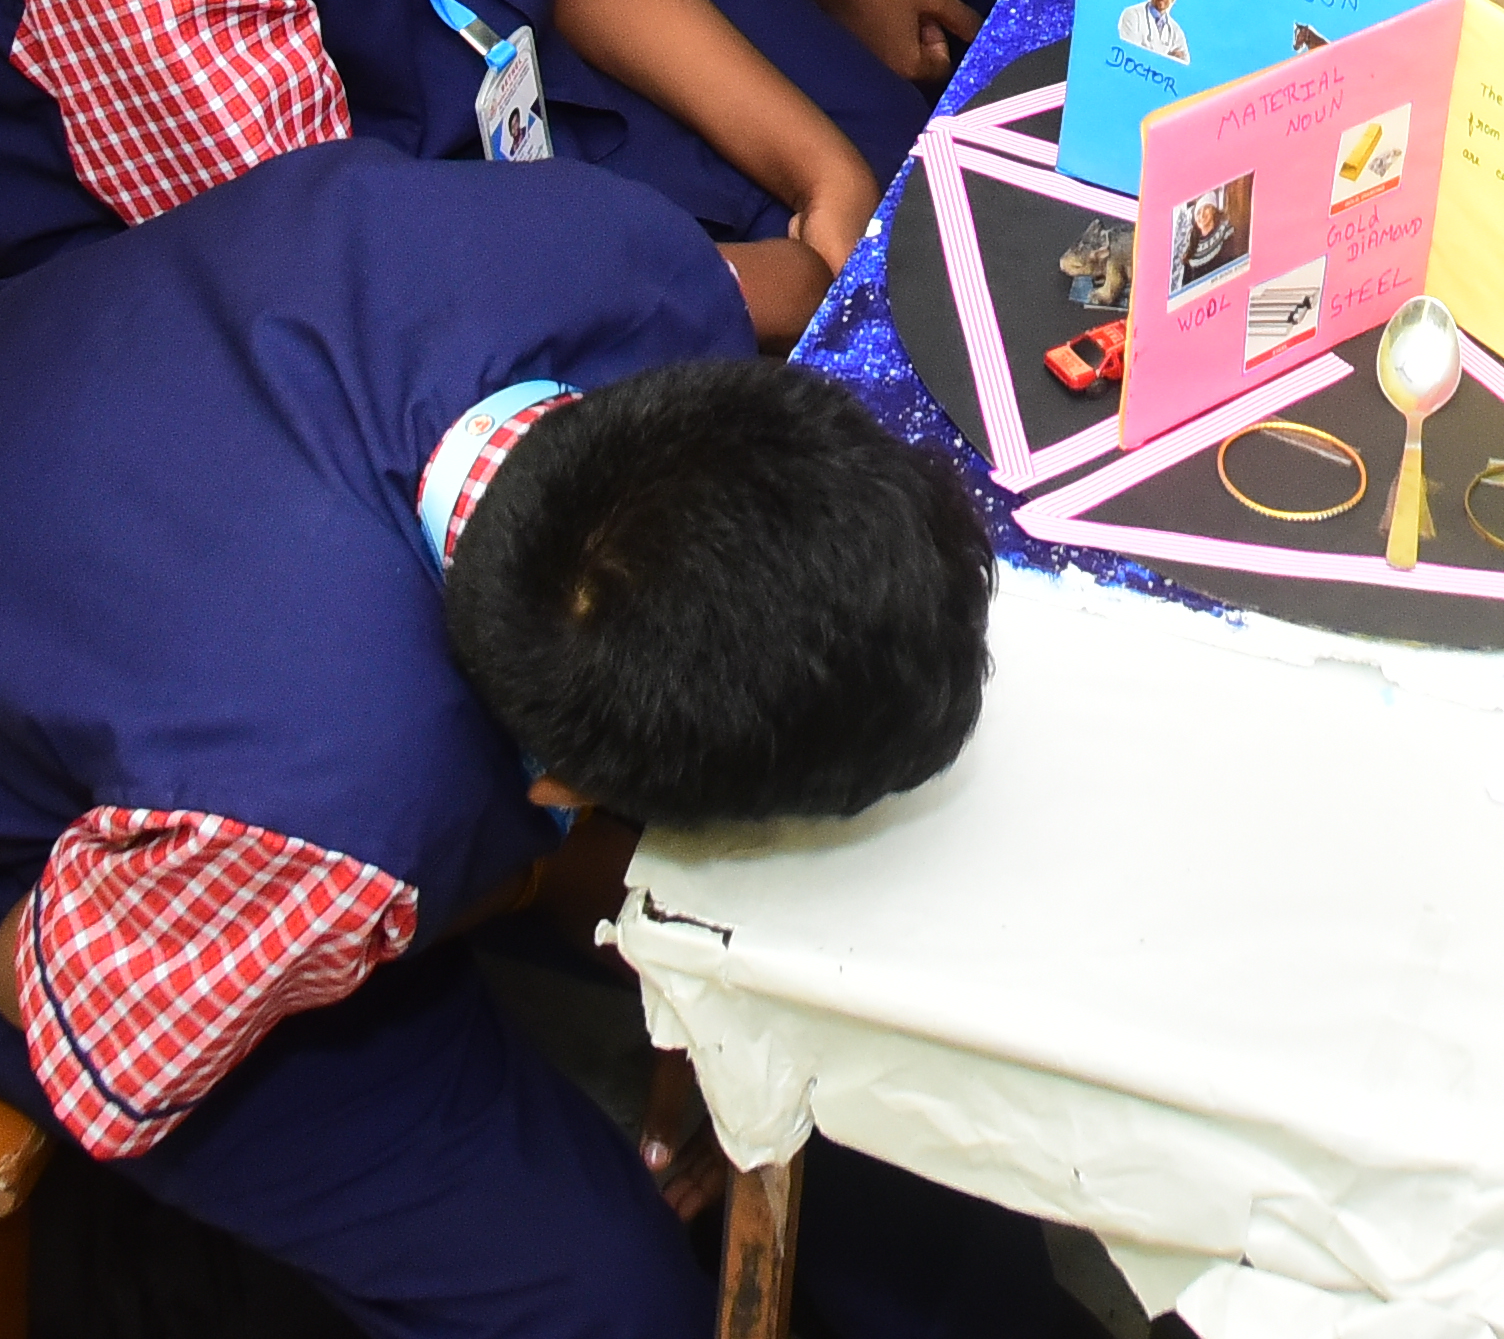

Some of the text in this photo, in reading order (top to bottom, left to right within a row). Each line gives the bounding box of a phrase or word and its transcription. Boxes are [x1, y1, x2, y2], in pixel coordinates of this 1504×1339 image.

[1216, 66, 1345, 140] MATERIAL
[1480, 81, 1504, 106] The
[1285, 90, 1345, 137] NOUN
[1467, 111, 1501, 141] from
[1462, 147, 1481, 167] are
